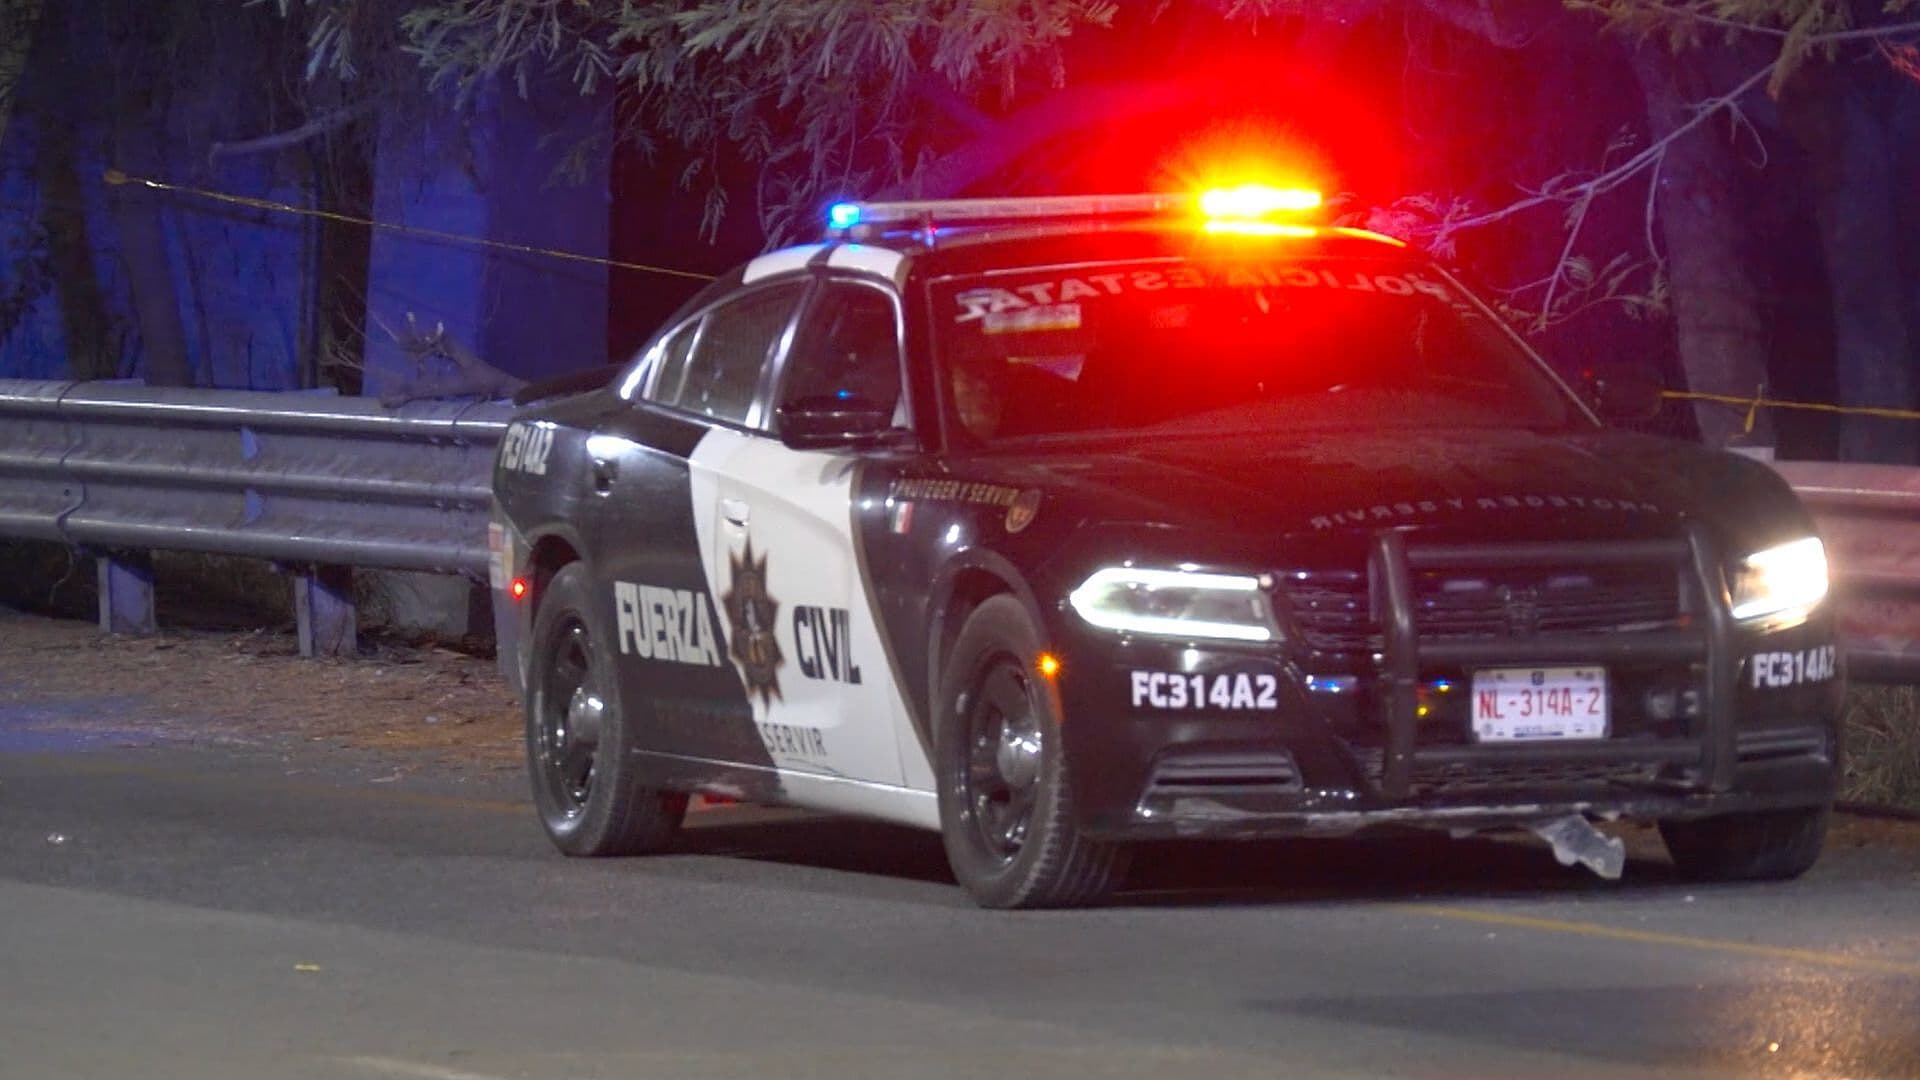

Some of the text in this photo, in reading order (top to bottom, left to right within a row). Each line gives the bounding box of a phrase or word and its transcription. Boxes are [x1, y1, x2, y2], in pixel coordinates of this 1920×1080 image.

[614, 581, 861, 685] FUERZA CIVIL
[1753, 644, 1835, 689] FC314A2
[1131, 671, 1278, 709] FC314A2
[1478, 686, 1601, 720] NL-314A-2
[763, 722, 827, 756] SERVIR
